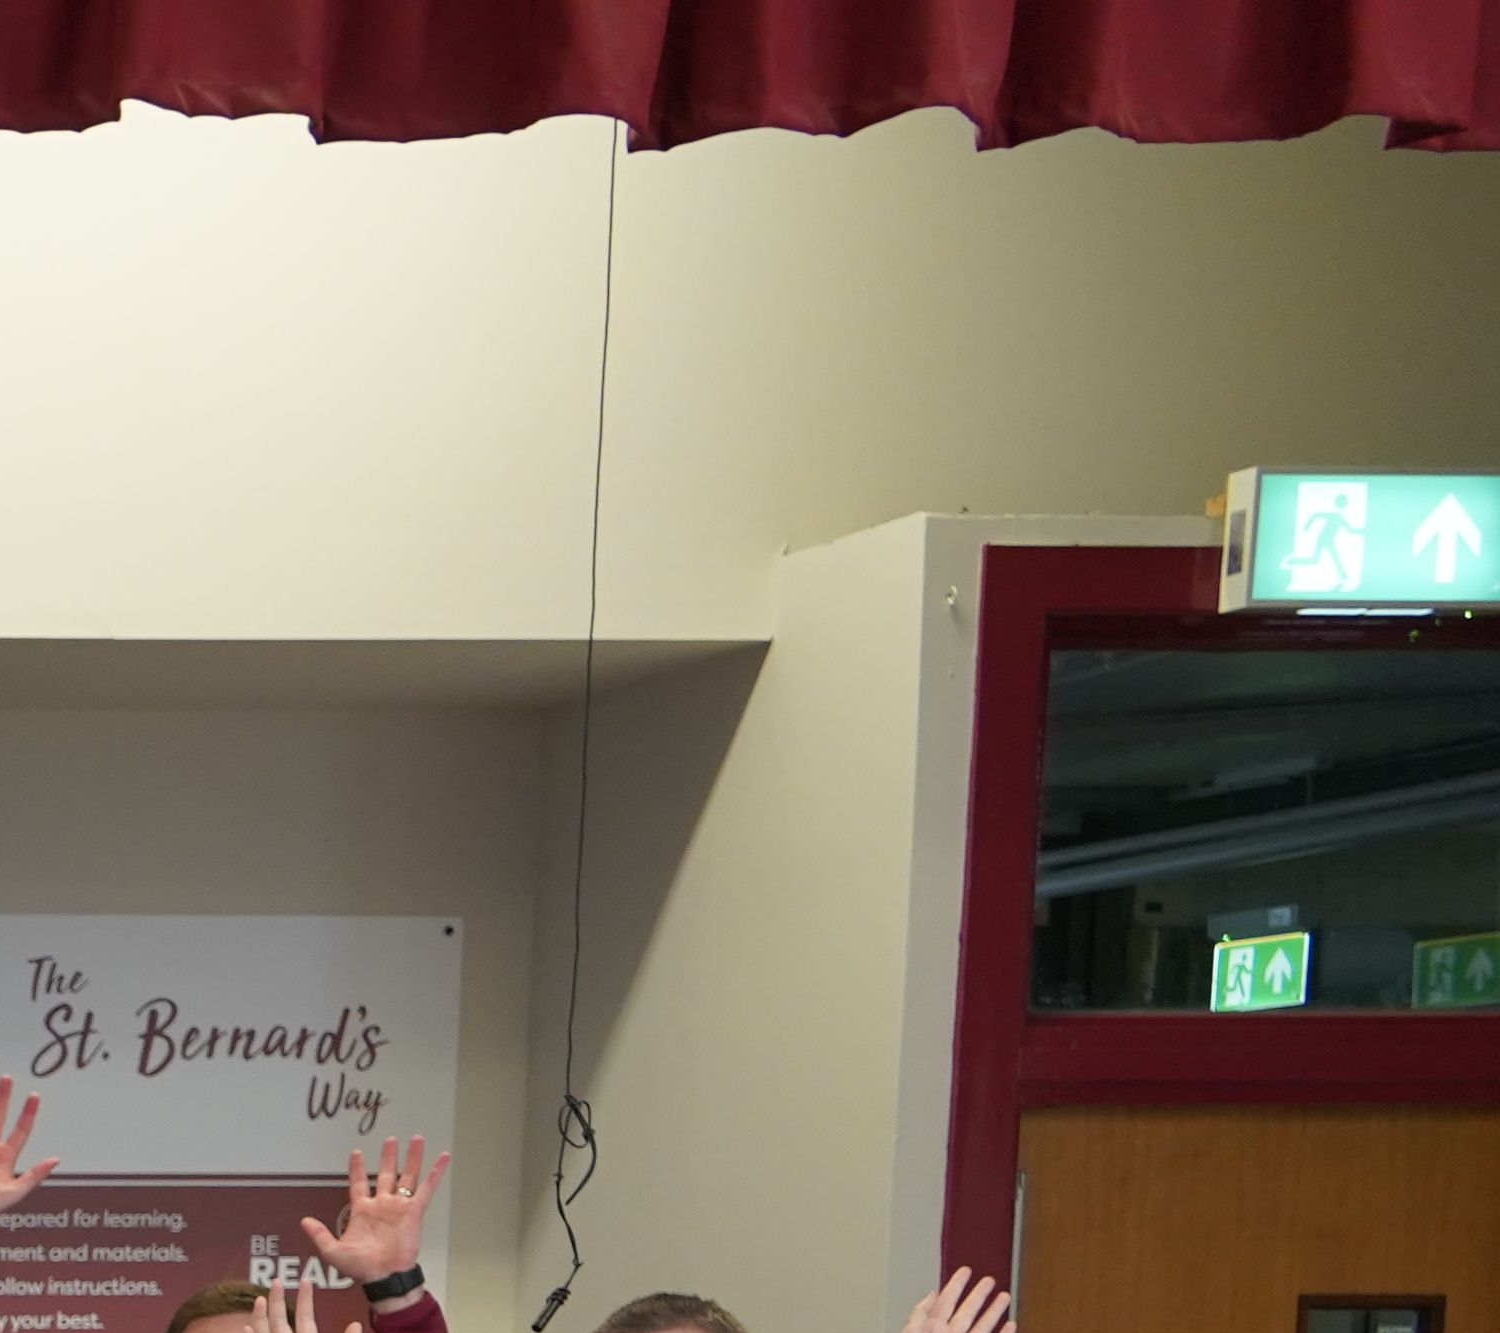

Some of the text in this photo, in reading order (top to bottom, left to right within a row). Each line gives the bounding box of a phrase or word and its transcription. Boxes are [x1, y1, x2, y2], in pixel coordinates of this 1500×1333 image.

[26, 955, 90, 1003] The
[31, 997, 391, 1079] St. Bernard's
[306, 1075, 390, 1136] Way
[72, 1207, 101, 1229] for
[103, 1207, 188, 1234] learning.
[49, 1243, 89, 1263] and
[92, 1243, 189, 1263] materials.
[250, 1234, 281, 1256] BE
[47, 1275, 164, 1297] instructions.
[56, 1310, 105, 1331] best.
